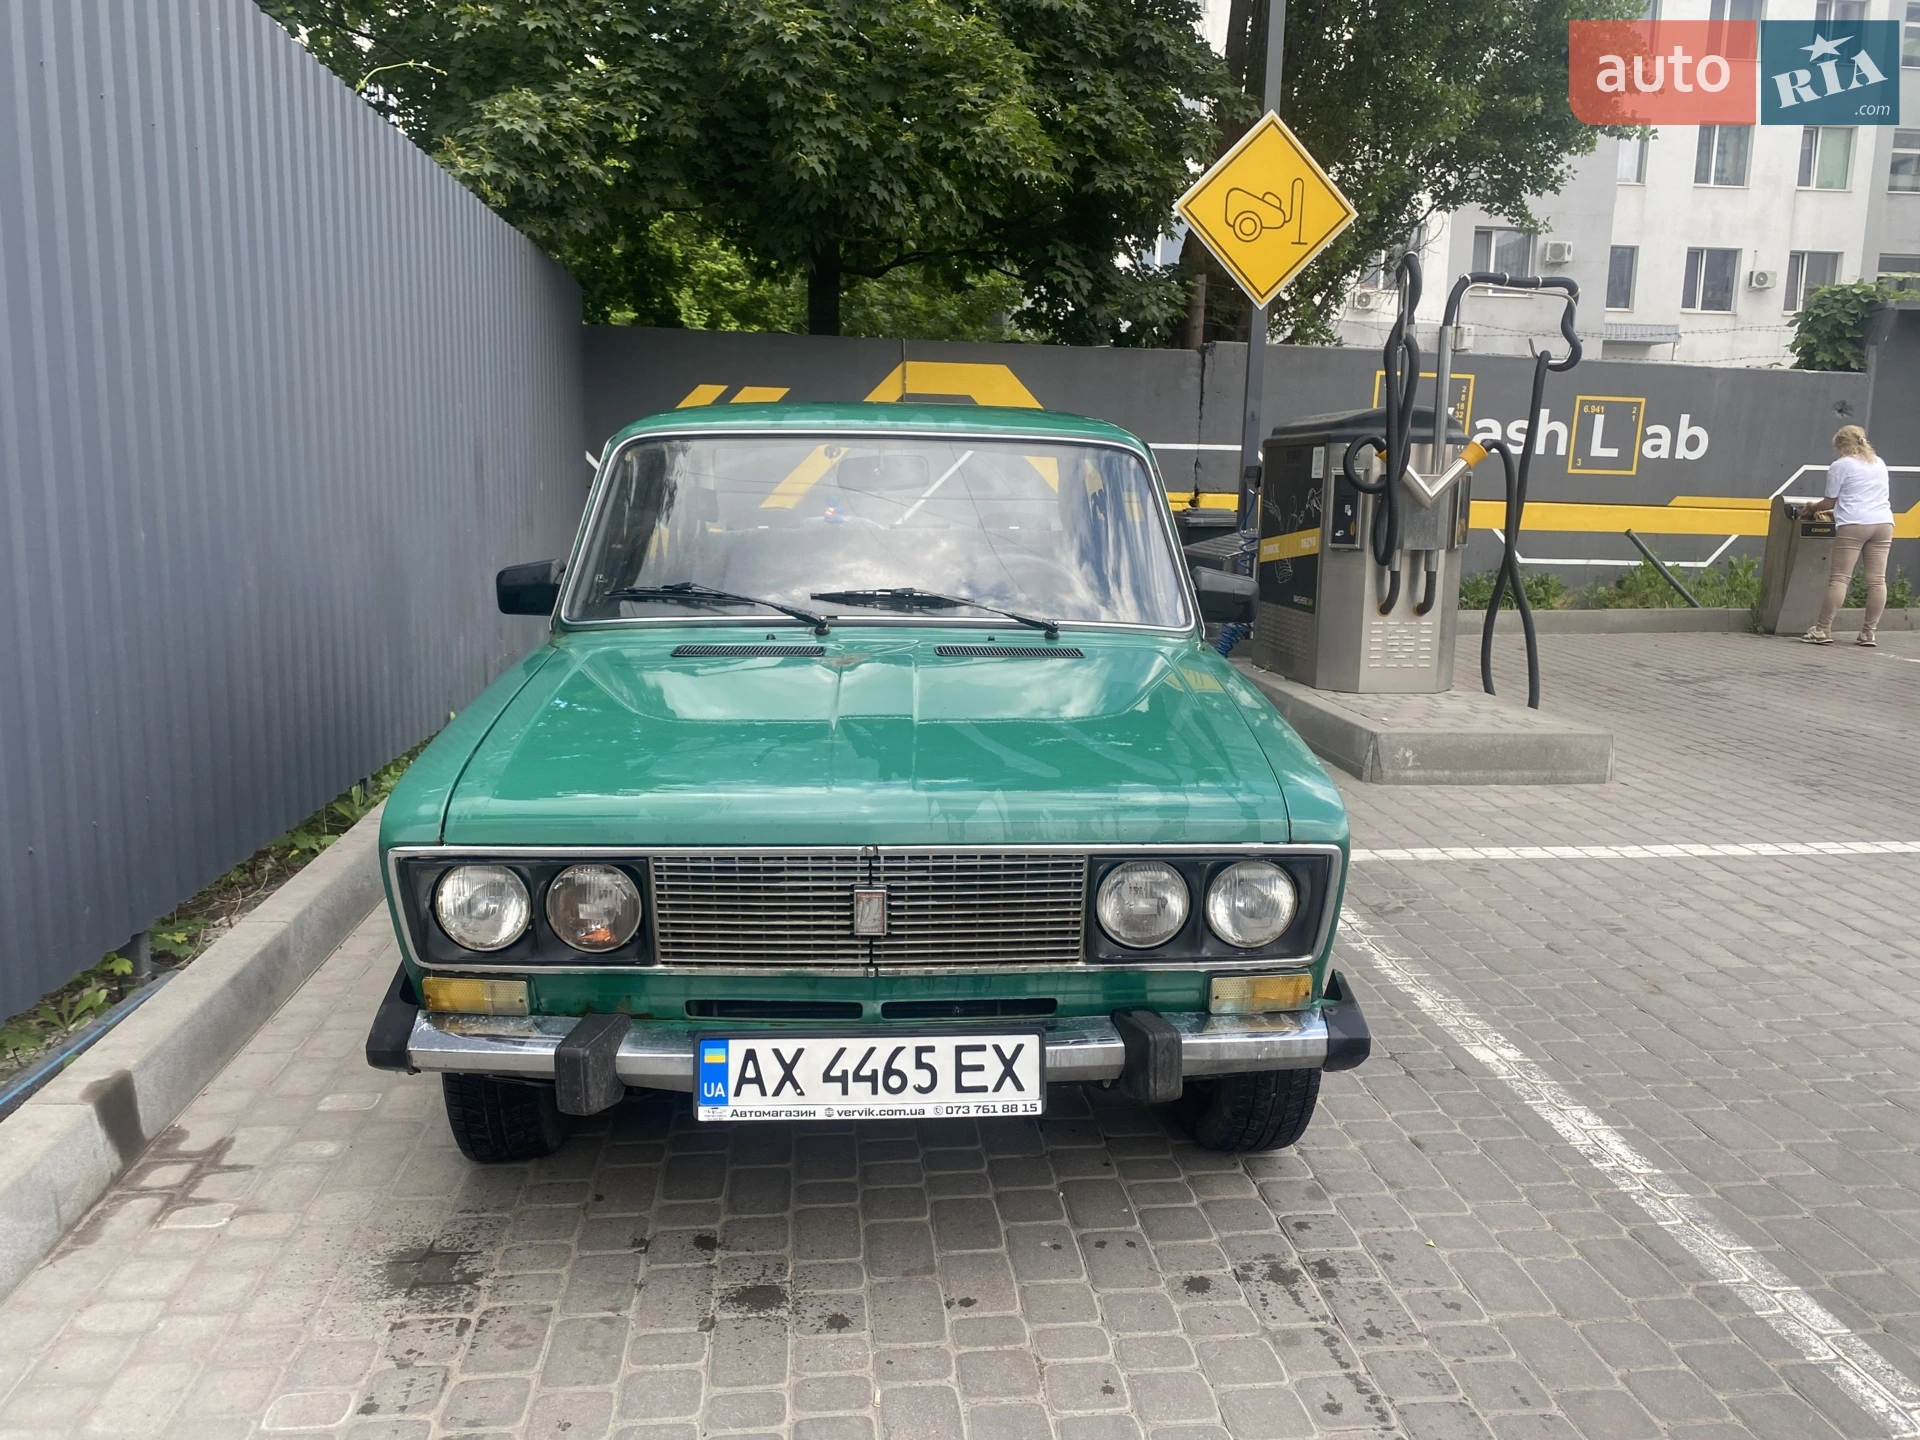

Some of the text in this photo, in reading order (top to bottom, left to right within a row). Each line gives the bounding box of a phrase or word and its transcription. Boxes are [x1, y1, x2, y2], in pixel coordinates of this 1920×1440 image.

[1583, 405, 1605, 413] 6.941
[1576, 458, 1582, 466] 3
[733, 1043, 1025, 1097] AX 4465 EX
[704, 1082, 726, 1098] UA
[730, 1108, 816, 1118] Автомагазин
[836, 1107, 925, 1117] vervik.com.ua
[945, 1103, 1038, 1115] 073 761 88 15
